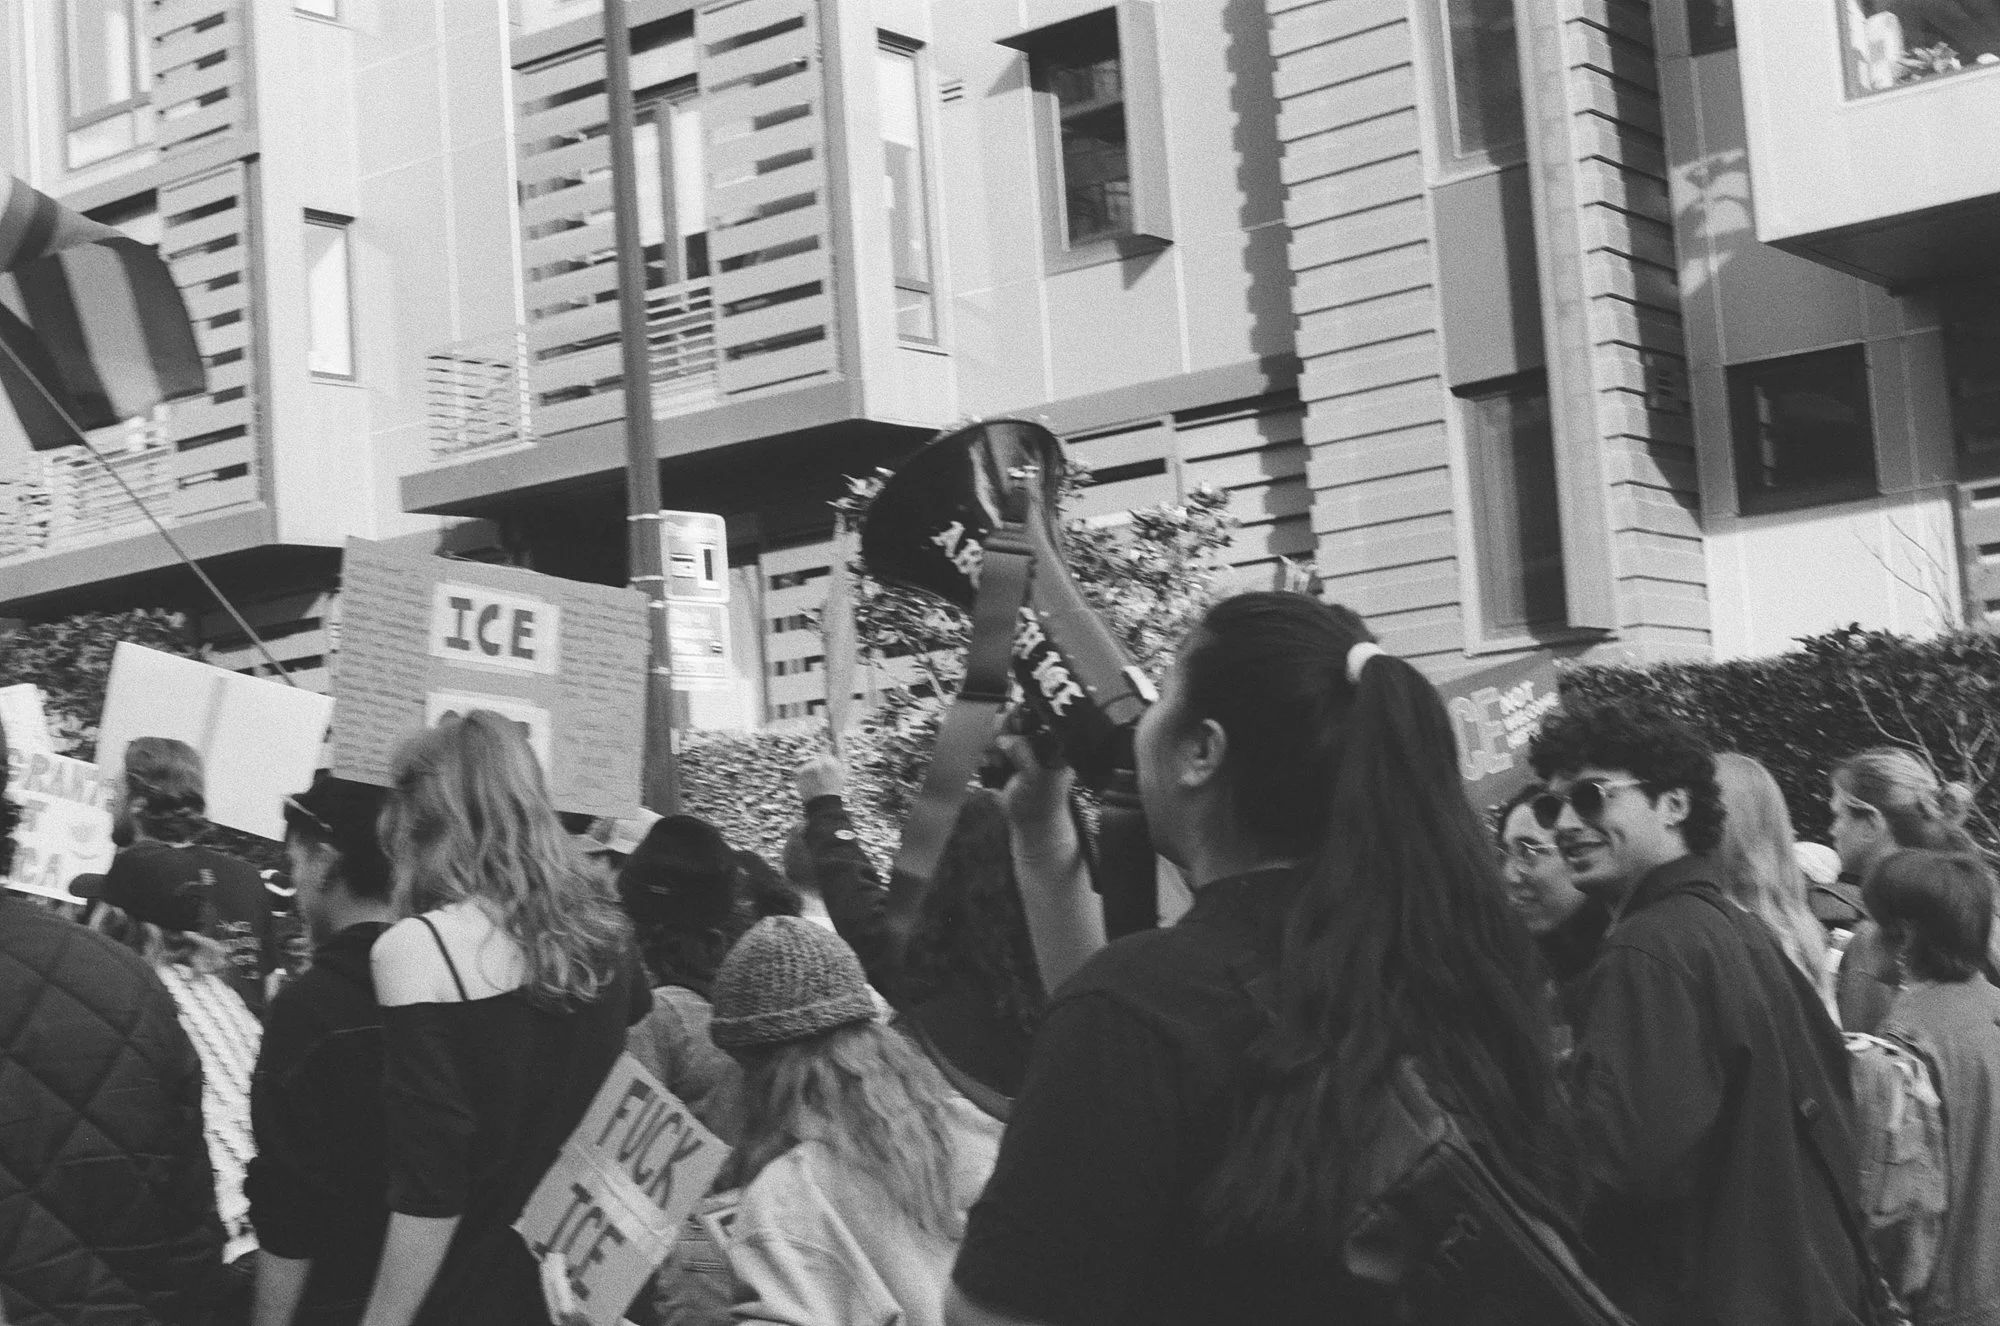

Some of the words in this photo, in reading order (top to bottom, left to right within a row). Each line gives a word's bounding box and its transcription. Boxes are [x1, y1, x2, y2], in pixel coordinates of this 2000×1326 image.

[444, 595, 535, 661] ICE
[596, 1078, 705, 1211] FUCK
[533, 1182, 627, 1301] ICE
